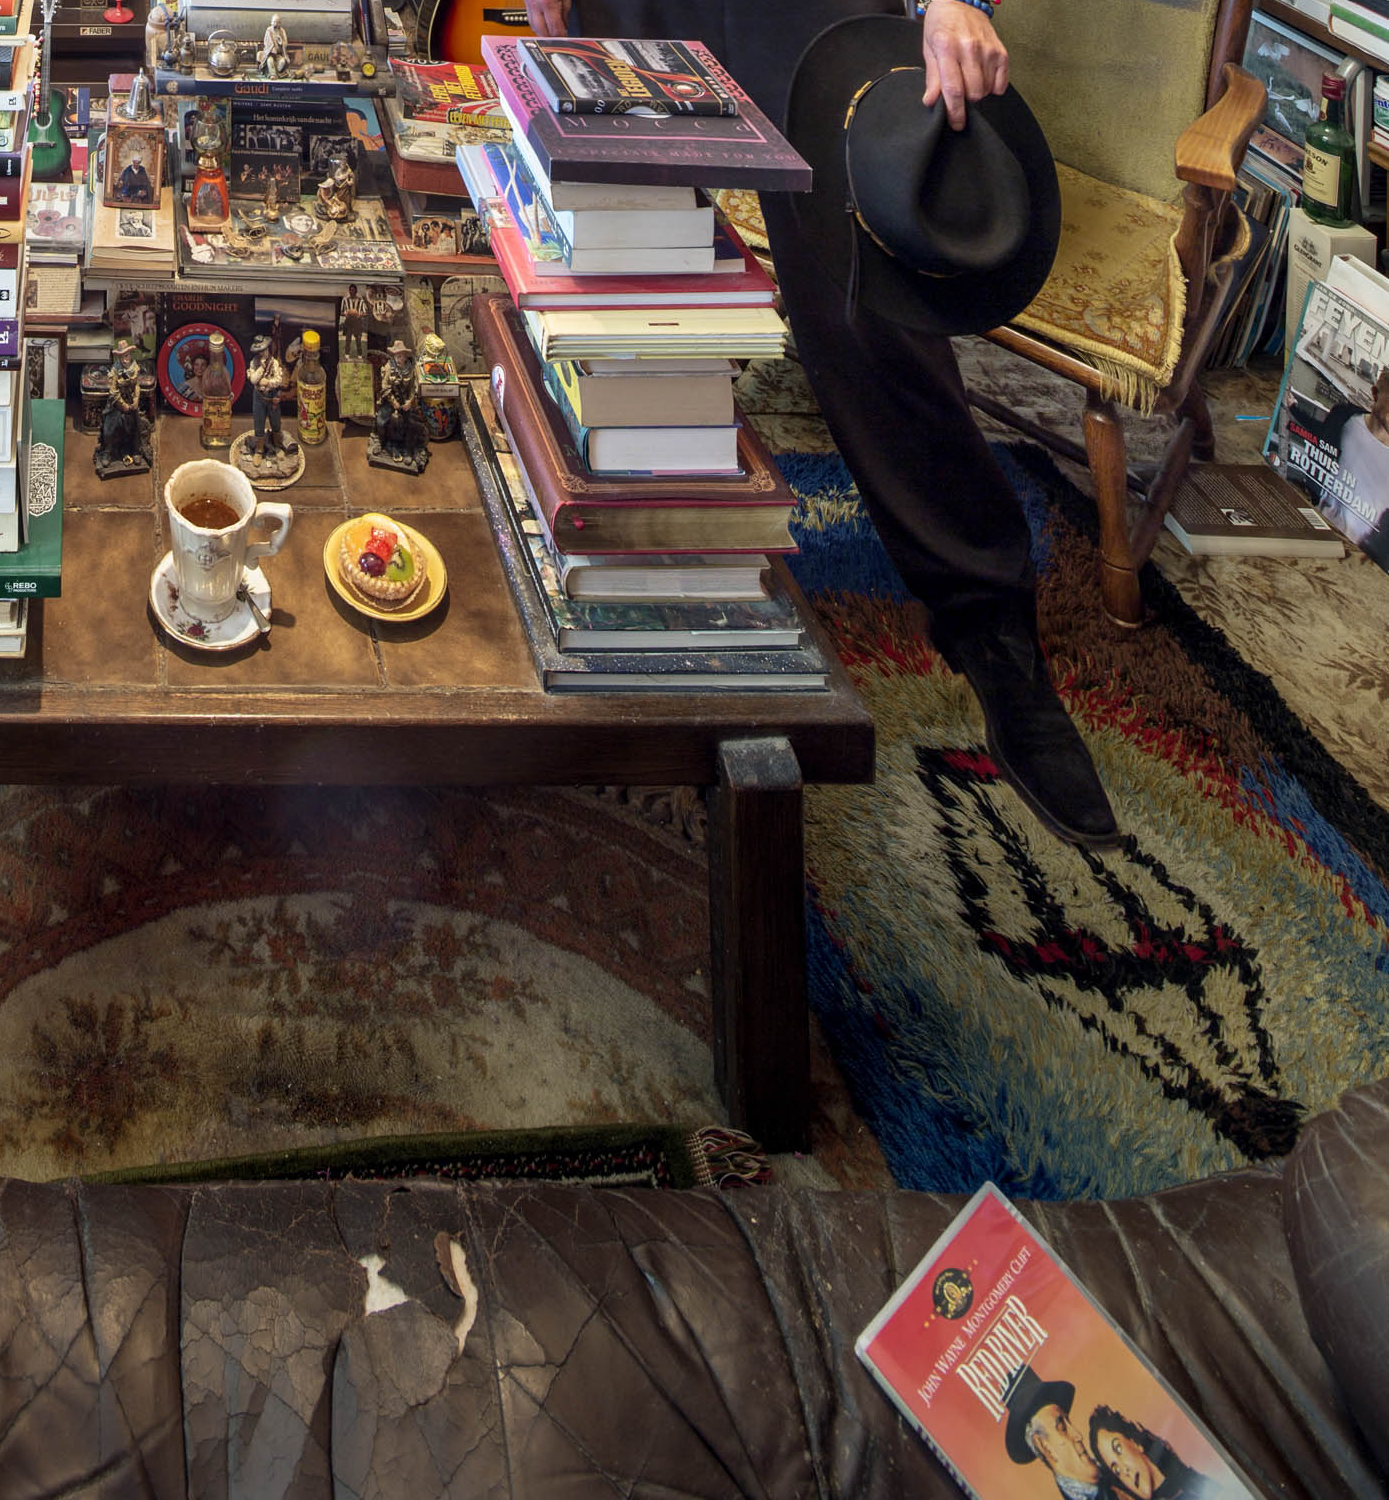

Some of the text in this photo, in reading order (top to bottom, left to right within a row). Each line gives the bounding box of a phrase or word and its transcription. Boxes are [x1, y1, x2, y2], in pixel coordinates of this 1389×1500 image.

[89, 27, 111, 36] FABER
[234, 82, 270, 94] Gaudí
[172, 302, 239, 312] GOODNIGHT
[1289, 421, 1338, 457] SAMBA SAM
[1303, 439, 1357, 488] THUIS IN
[1290, 448, 1377, 525] ROTTERDAM
[917, 1245, 1032, 1408] JOHN WAYNE MONTGOMERY CLIFT
[956, 1295, 1048, 1423] RED RIVER
